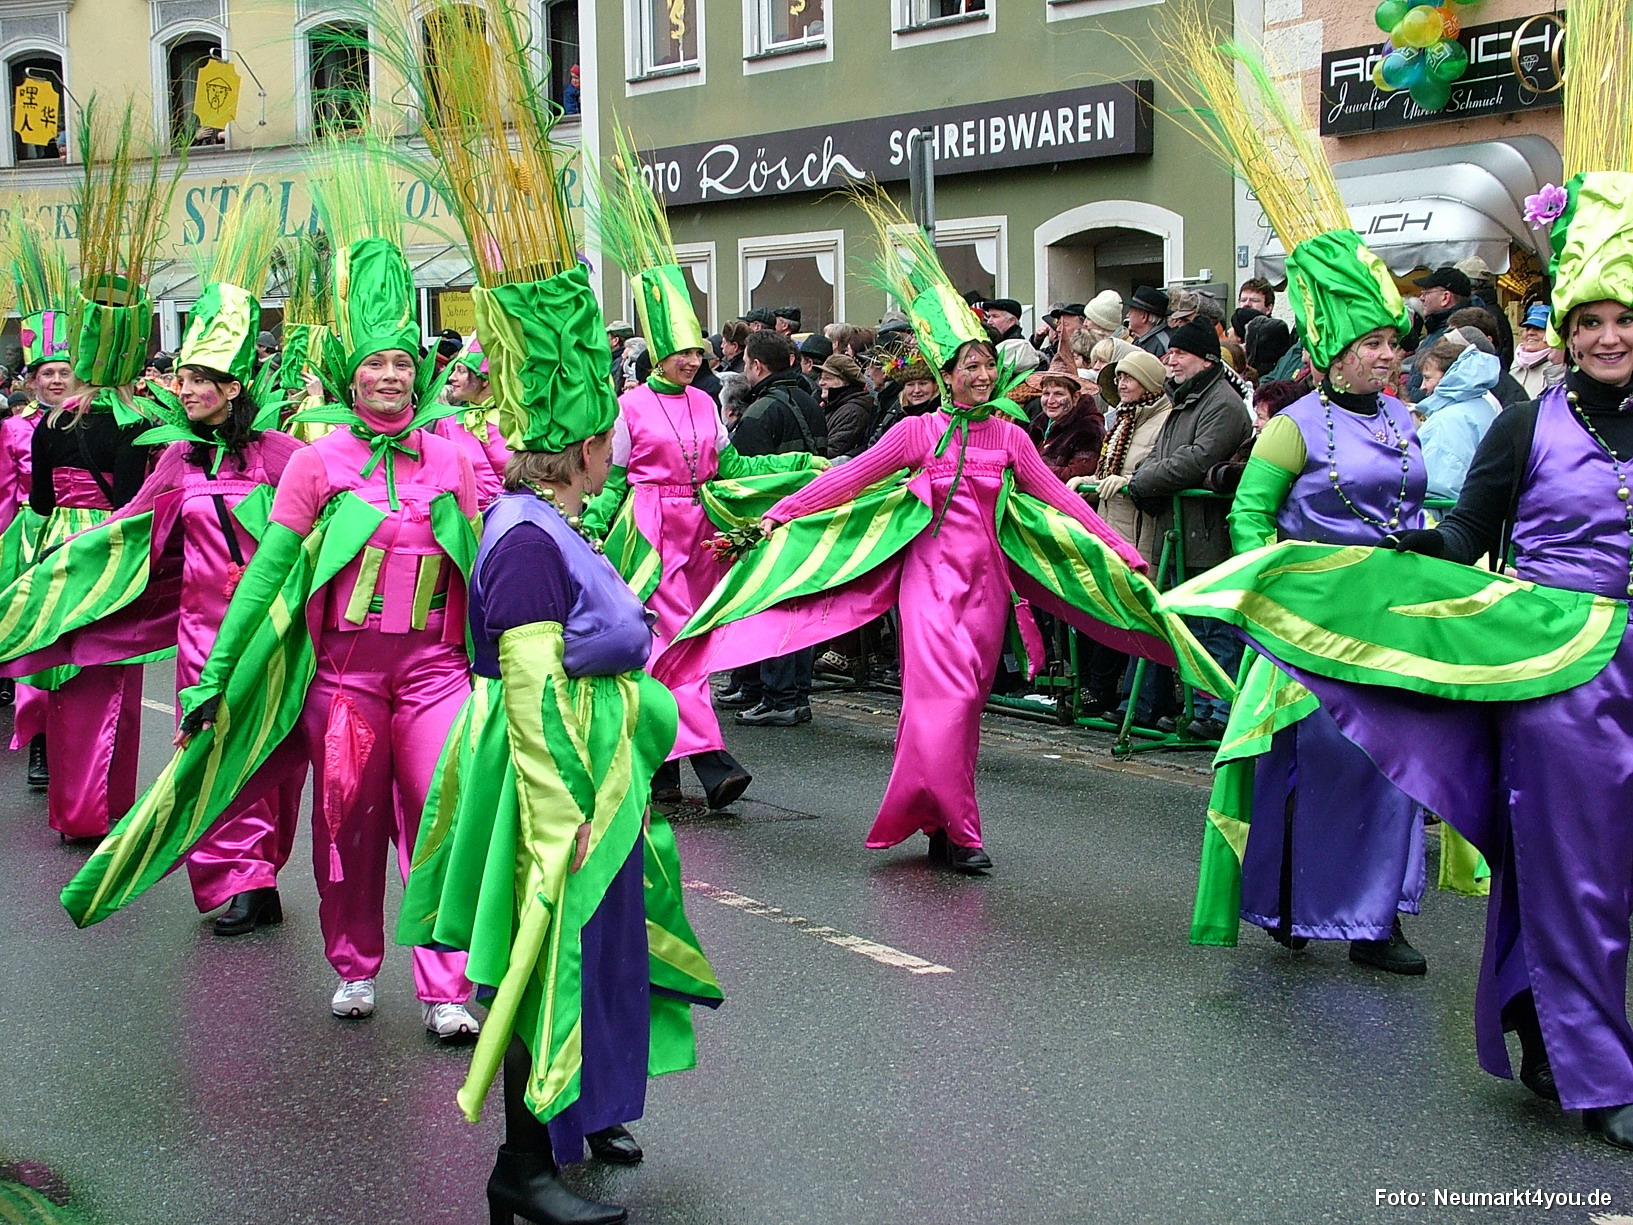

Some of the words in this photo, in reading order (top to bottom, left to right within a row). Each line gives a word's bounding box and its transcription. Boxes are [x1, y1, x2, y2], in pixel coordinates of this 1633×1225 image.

[1328, 81, 1405, 123] Juwelier
[1446, 84, 1504, 113] Schmuck
[696, 135, 866, 199] Rösch
